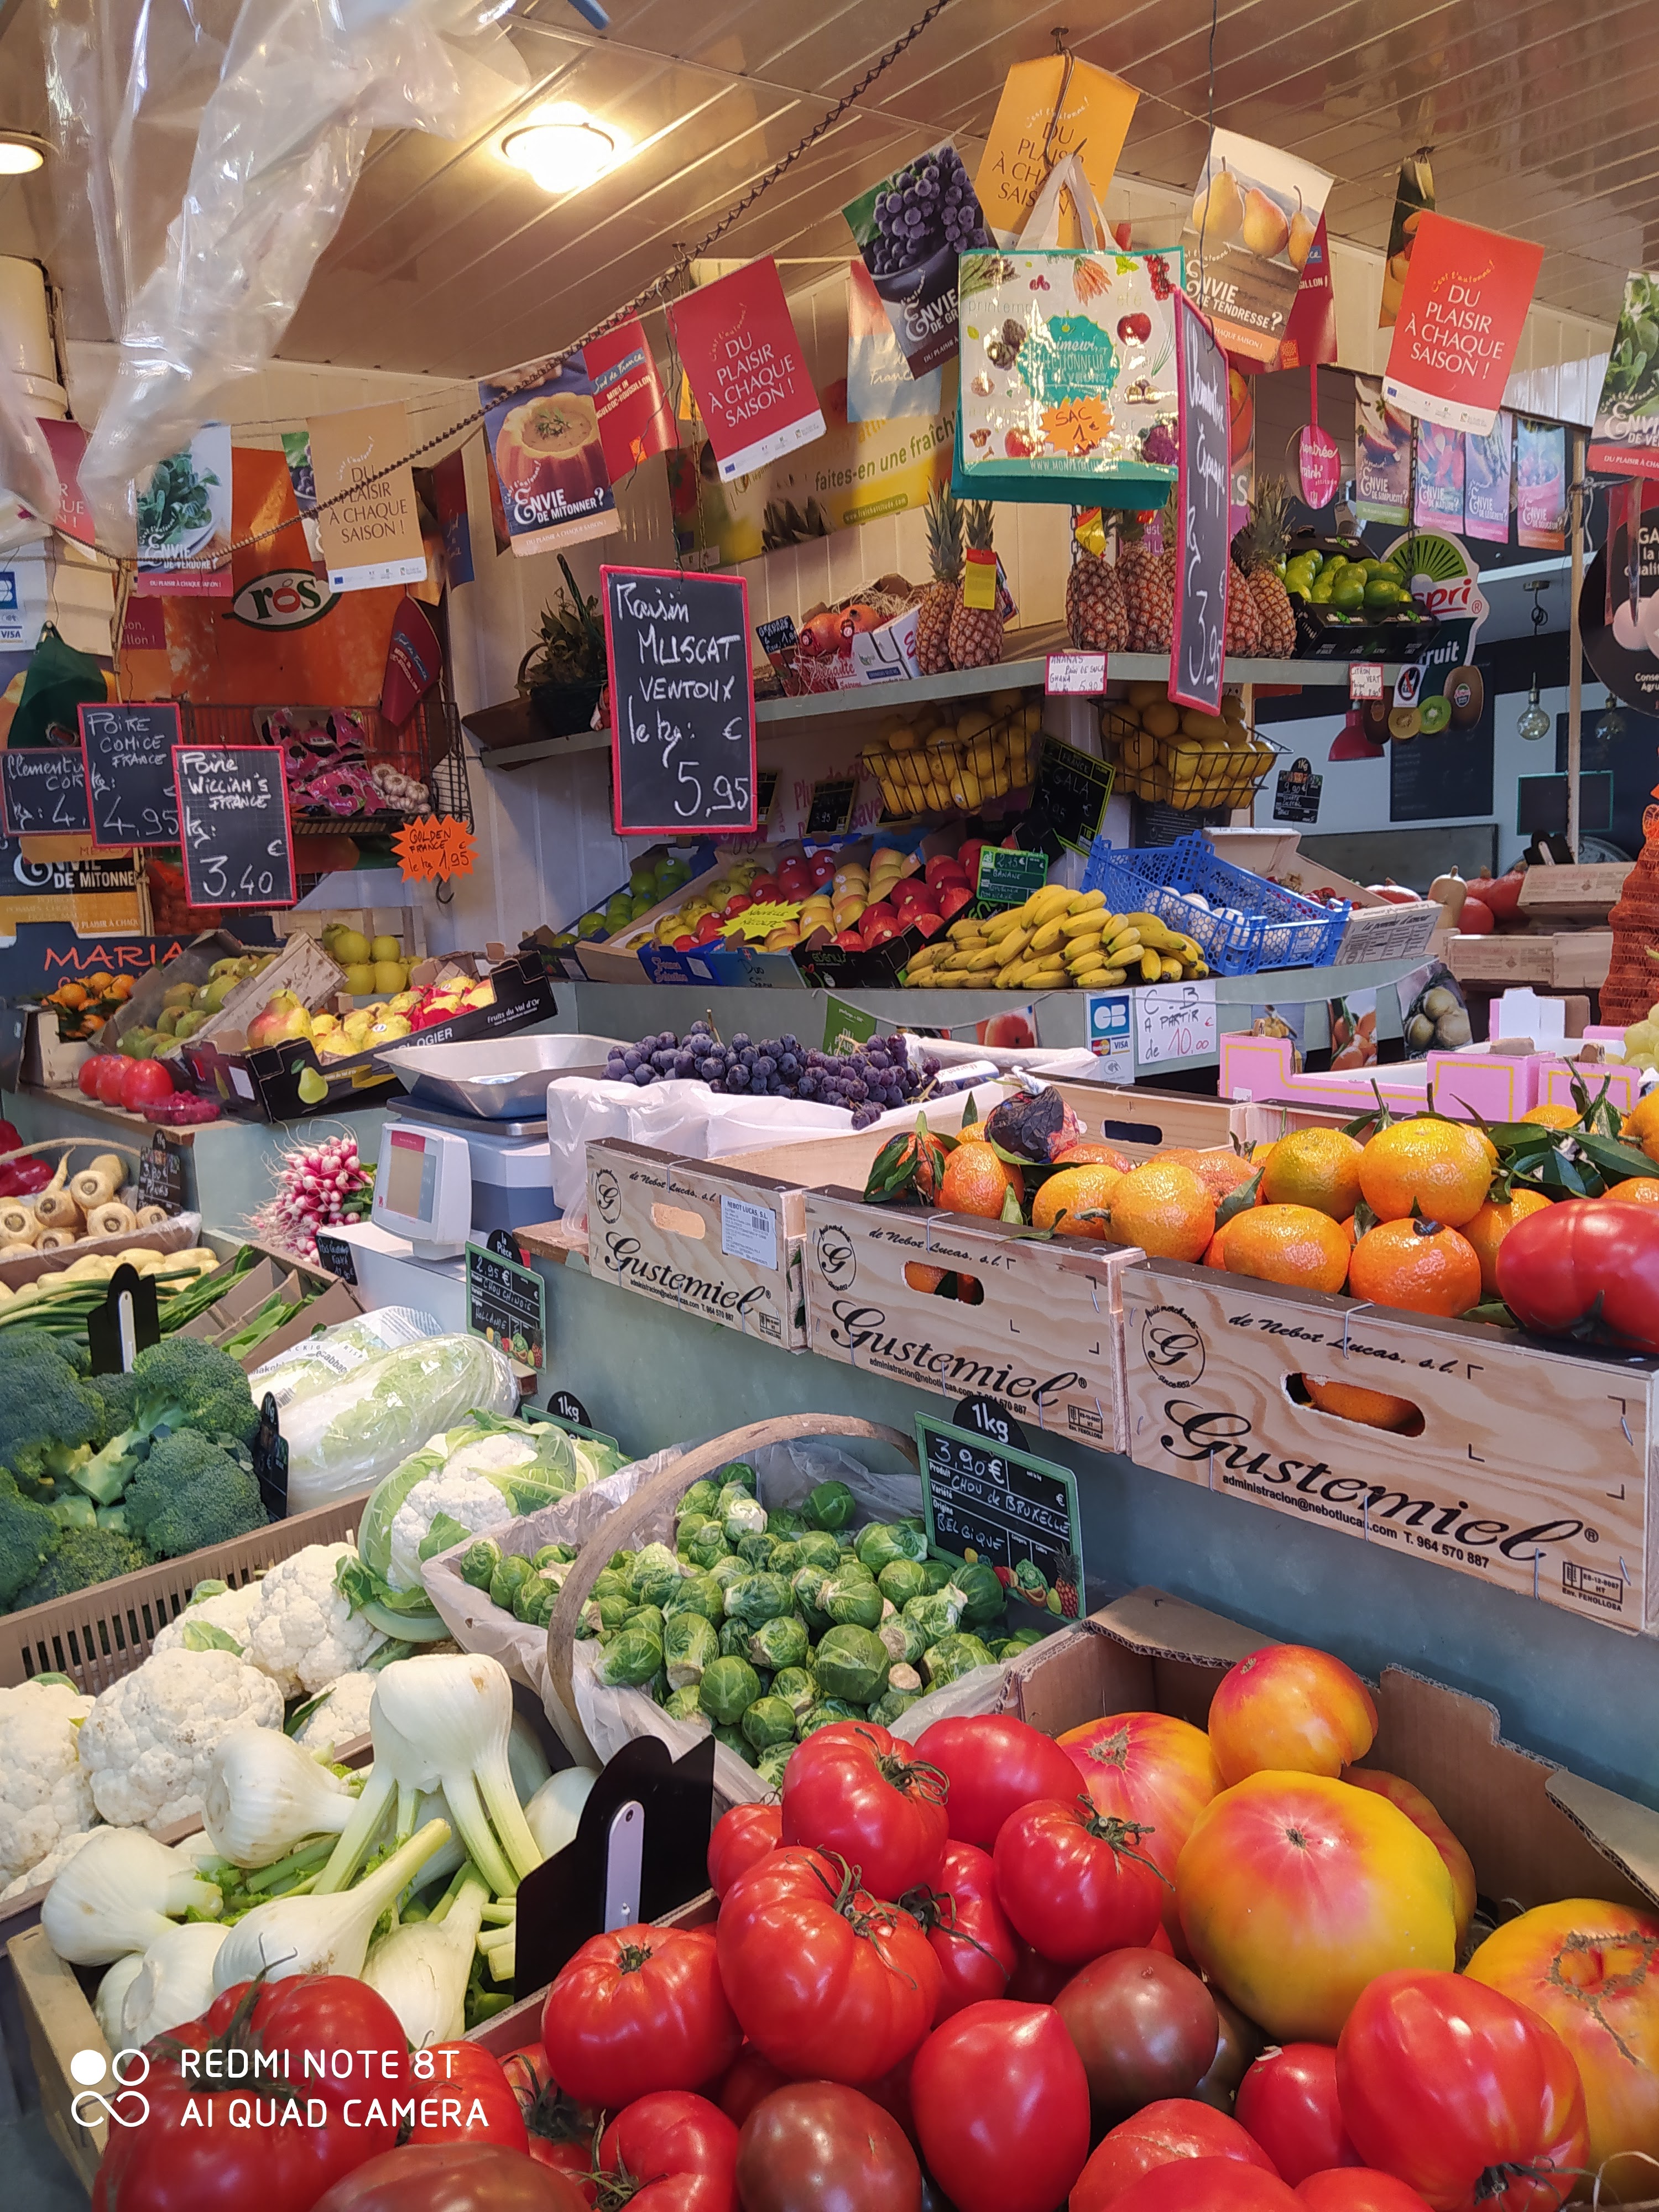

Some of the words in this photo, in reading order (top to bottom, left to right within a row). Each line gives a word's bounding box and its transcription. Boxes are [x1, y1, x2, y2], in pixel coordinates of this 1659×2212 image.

[1448, 284, 1481, 307] DU
[930, 319, 944, 334] DE
[1426, 301, 1492, 335] PLAISIR
[725, 331, 753, 359] DU
[1405, 312, 1416, 336] À
[1421, 324, 1505, 359] CHAQUE
[716, 343, 775, 387] PLAISIR
[1410, 342, 1479, 377] SAISON
[708, 392, 723, 414] À
[724, 353, 796, 405] CHAQUE
[726, 382, 785, 428] SAISON
[1056, 407, 1092, 426] SAC
[880, 446, 906, 471] une
[343, 499, 408, 524] CHAQUE
[514, 487, 567, 525] ENVIE
[537, 512, 549, 524] DE
[341, 520, 396, 544] SAISON
[638, 623, 740, 664] MUSCAT
[639, 675, 735, 702] VENTOUX
[722, 717, 742, 740] €
[111, 753, 167, 769] FRANCE
[674, 760, 749, 818] 5,95
[409, 827, 451, 844] GOLDEN
[409, 839, 448, 854] FRANCE
[267, 839, 285, 857] €
[55, 873, 75, 888] DE
[200, 854, 273, 899] 3,40
[487, 1011, 505, 1024] Fruits
[506, 1006, 514, 1016] du
[515, 1003, 526, 1013] Val
[1144, 1017, 1152, 1033] A
[1160, 1009, 1199, 1030] PARTIR
[417, 1027, 453, 1046] OGIER
[1113, 1040, 1129, 1049] VISA
[1145, 1038, 1160, 1060] de
[629, 1171, 638, 1181] de
[640, 1174, 666, 1188] Nebot
[727, 1201, 742, 1211] NEBOT
[497, 1240, 512, 1259] Pièce
[502, 1232, 507, 1245] la
[869, 1228, 884, 1240] de
[887, 1231, 925, 1250] Nebot
[483, 1278, 500, 1298] CHOU
[502, 1270, 510, 1287] €
[706, 1305, 715, 1314] 964
[716, 1309, 724, 1318] 570
[1229, 1312, 1253, 1327] de
[1258, 1319, 1324, 1343] Nebot
[557, 1395, 580, 1423] 1kg
[1014, 1404, 1027, 1416] 887
[971, 1402, 1009, 1444] 1kg
[934, 1437, 985, 1476] 3,90
[988, 1459, 1005, 1484] €
[928, 1463, 951, 1478] Produit
[951, 1475, 982, 1495] CHOU
[931, 1483, 953, 1499] Variété
[1056, 1494, 1065, 1507] €
[933, 1498, 953, 1515] Origine
[1404, 1530, 1415, 1545] T.
[1417, 1536, 1439, 1553] 964
[1442, 1544, 1465, 1561] 570
[1467, 1552, 1490, 1569] 887
[1562, 1588, 1577, 1599] Env.
[1578, 1593, 1622, 1612] FENOLLOSA
